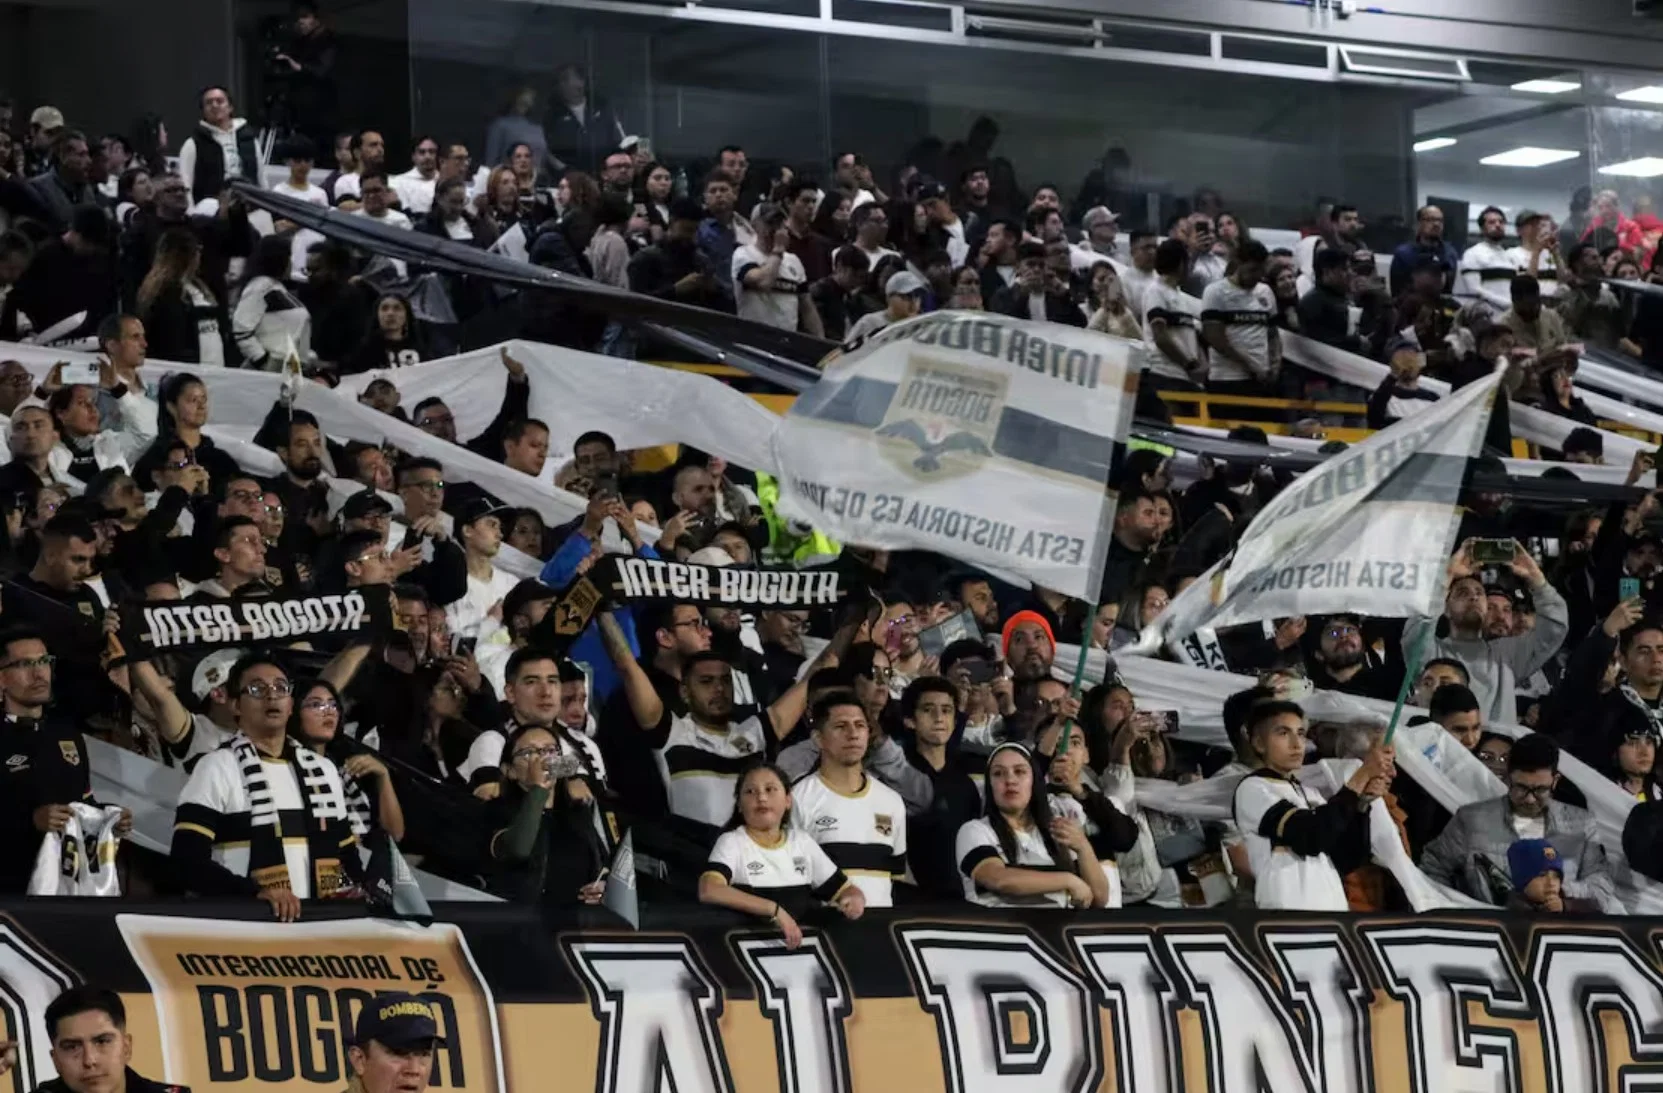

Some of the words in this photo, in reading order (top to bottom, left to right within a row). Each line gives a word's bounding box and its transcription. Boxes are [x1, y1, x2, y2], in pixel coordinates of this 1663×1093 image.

[614, 556, 711, 601] INTER
[143, 604, 243, 649] INTER
[175, 952, 402, 982] INTERNACIONAL
[399, 955, 446, 983] DE
